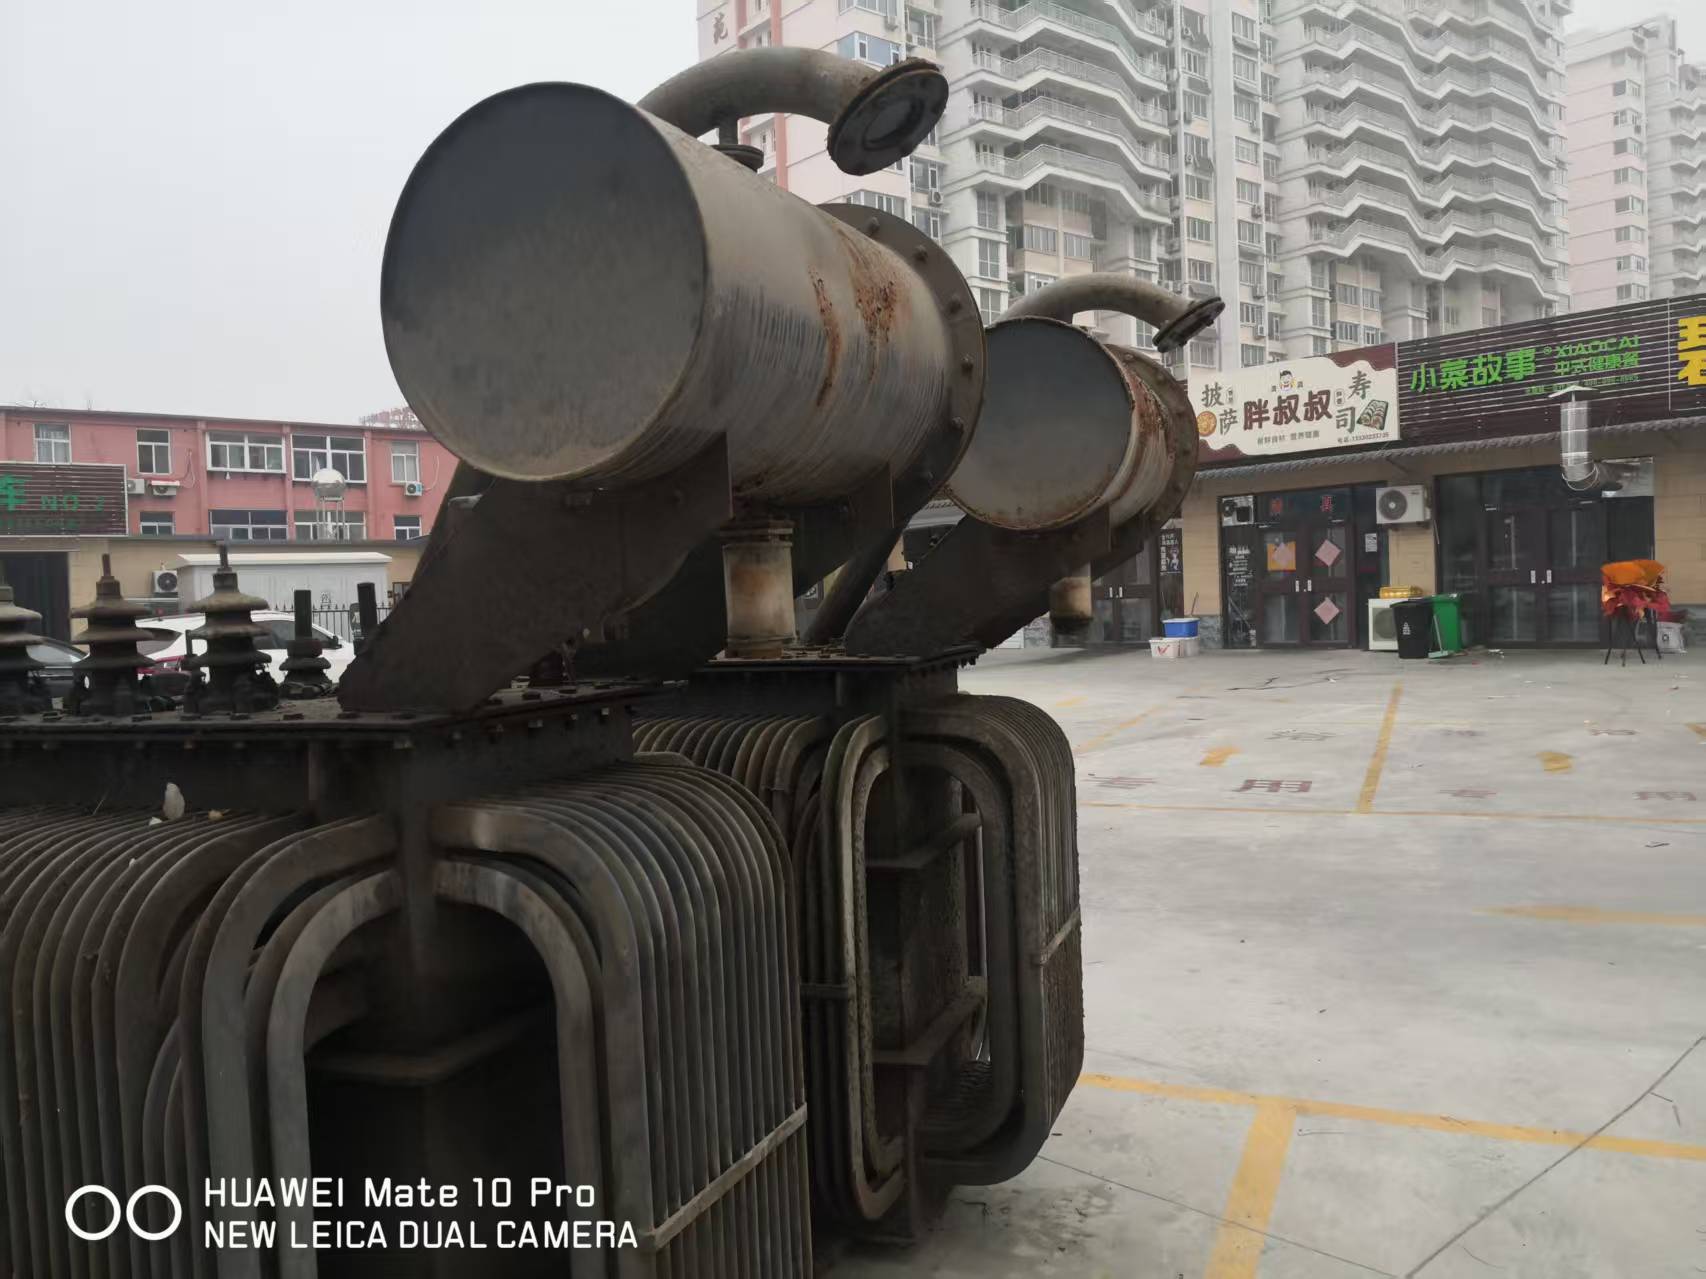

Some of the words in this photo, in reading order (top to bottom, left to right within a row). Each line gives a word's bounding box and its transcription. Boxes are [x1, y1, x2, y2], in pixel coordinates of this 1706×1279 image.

[1410, 348, 1536, 392] 小菜故事
[1201, 381, 1238, 435] 披萨
[1243, 389, 1333, 431] 胖叔叔
[1335, 370, 1372, 433] 寿司
